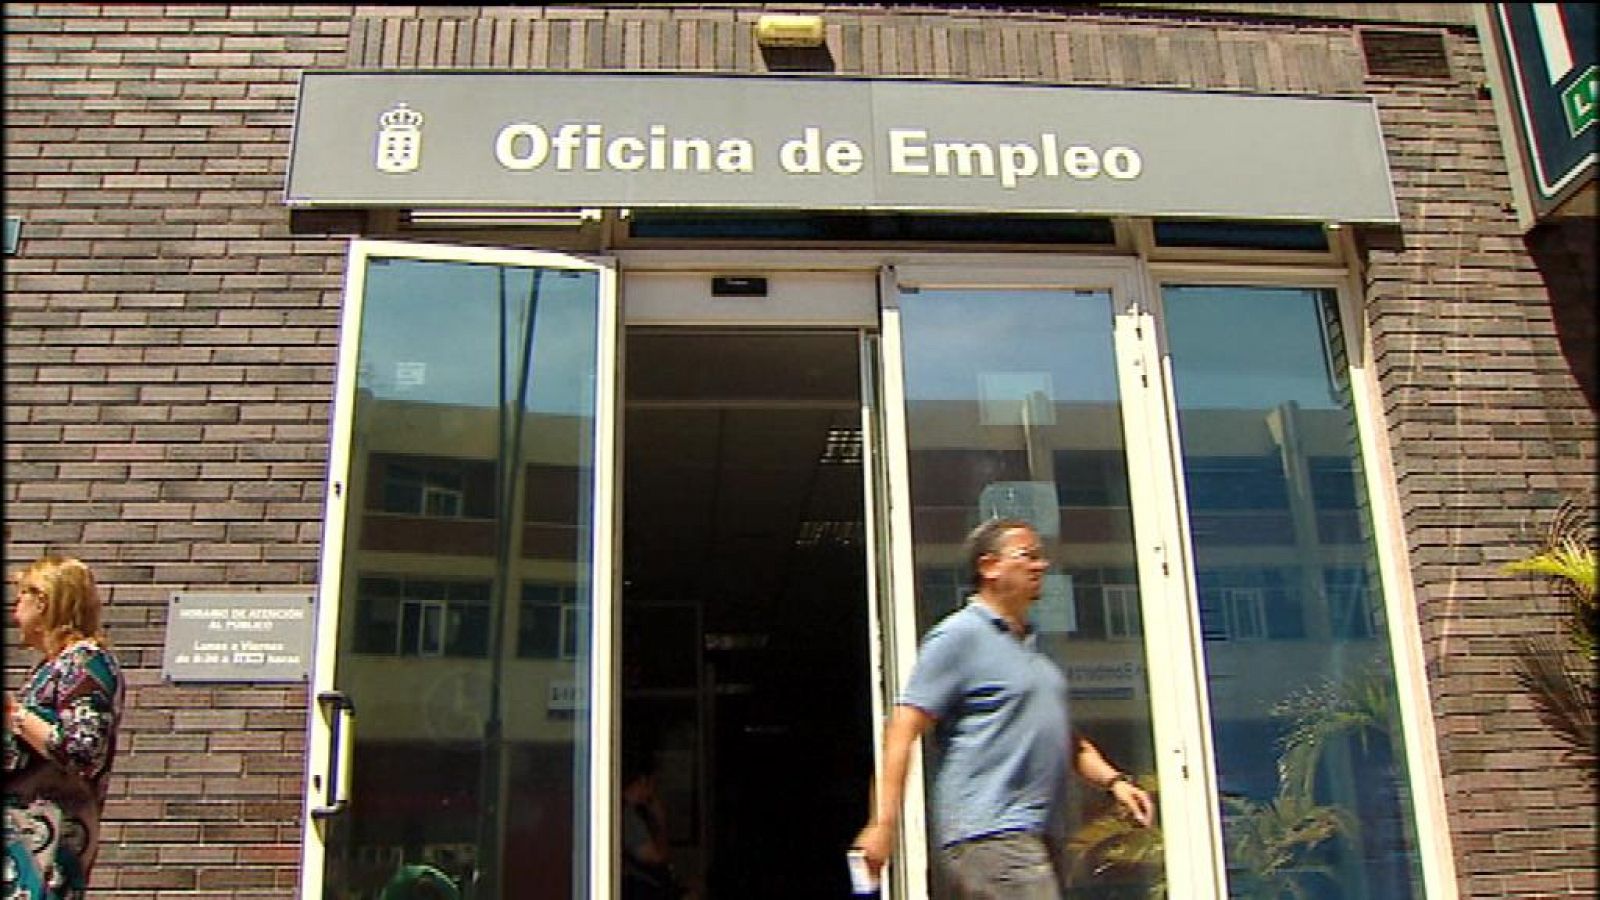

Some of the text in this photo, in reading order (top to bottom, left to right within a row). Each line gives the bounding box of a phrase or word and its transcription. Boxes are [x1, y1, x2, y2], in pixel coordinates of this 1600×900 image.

[496, 124, 1141, 188] Oficina de Empleo
